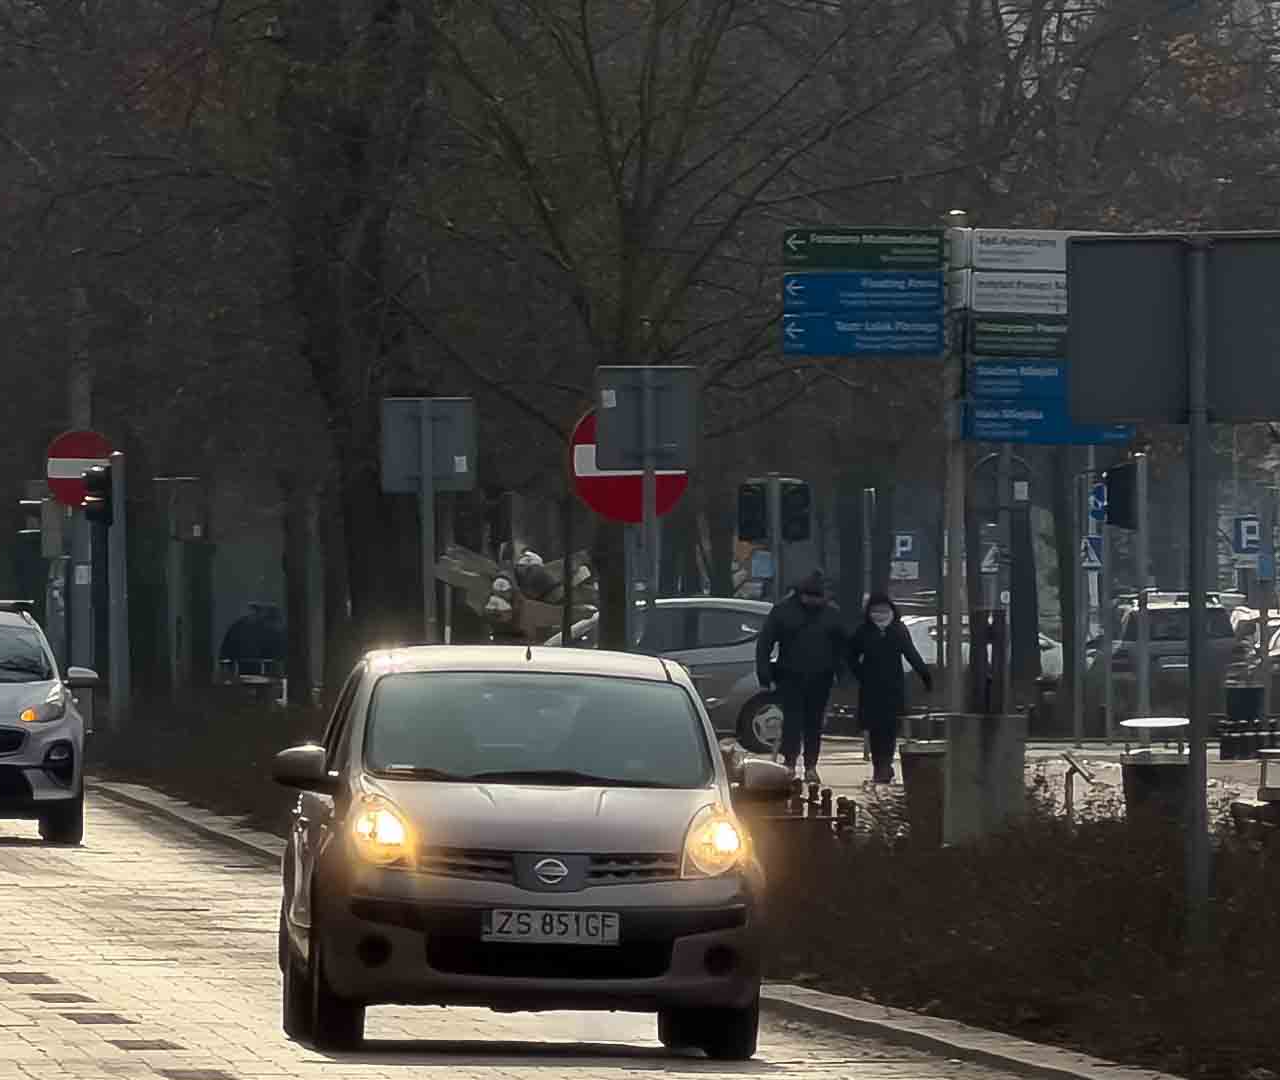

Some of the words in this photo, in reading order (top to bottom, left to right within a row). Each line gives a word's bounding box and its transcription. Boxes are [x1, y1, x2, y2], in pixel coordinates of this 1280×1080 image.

[896, 536, 912, 557] P
[496, 911, 532, 935] ZS
[541, 912, 617, 938] 851GF
